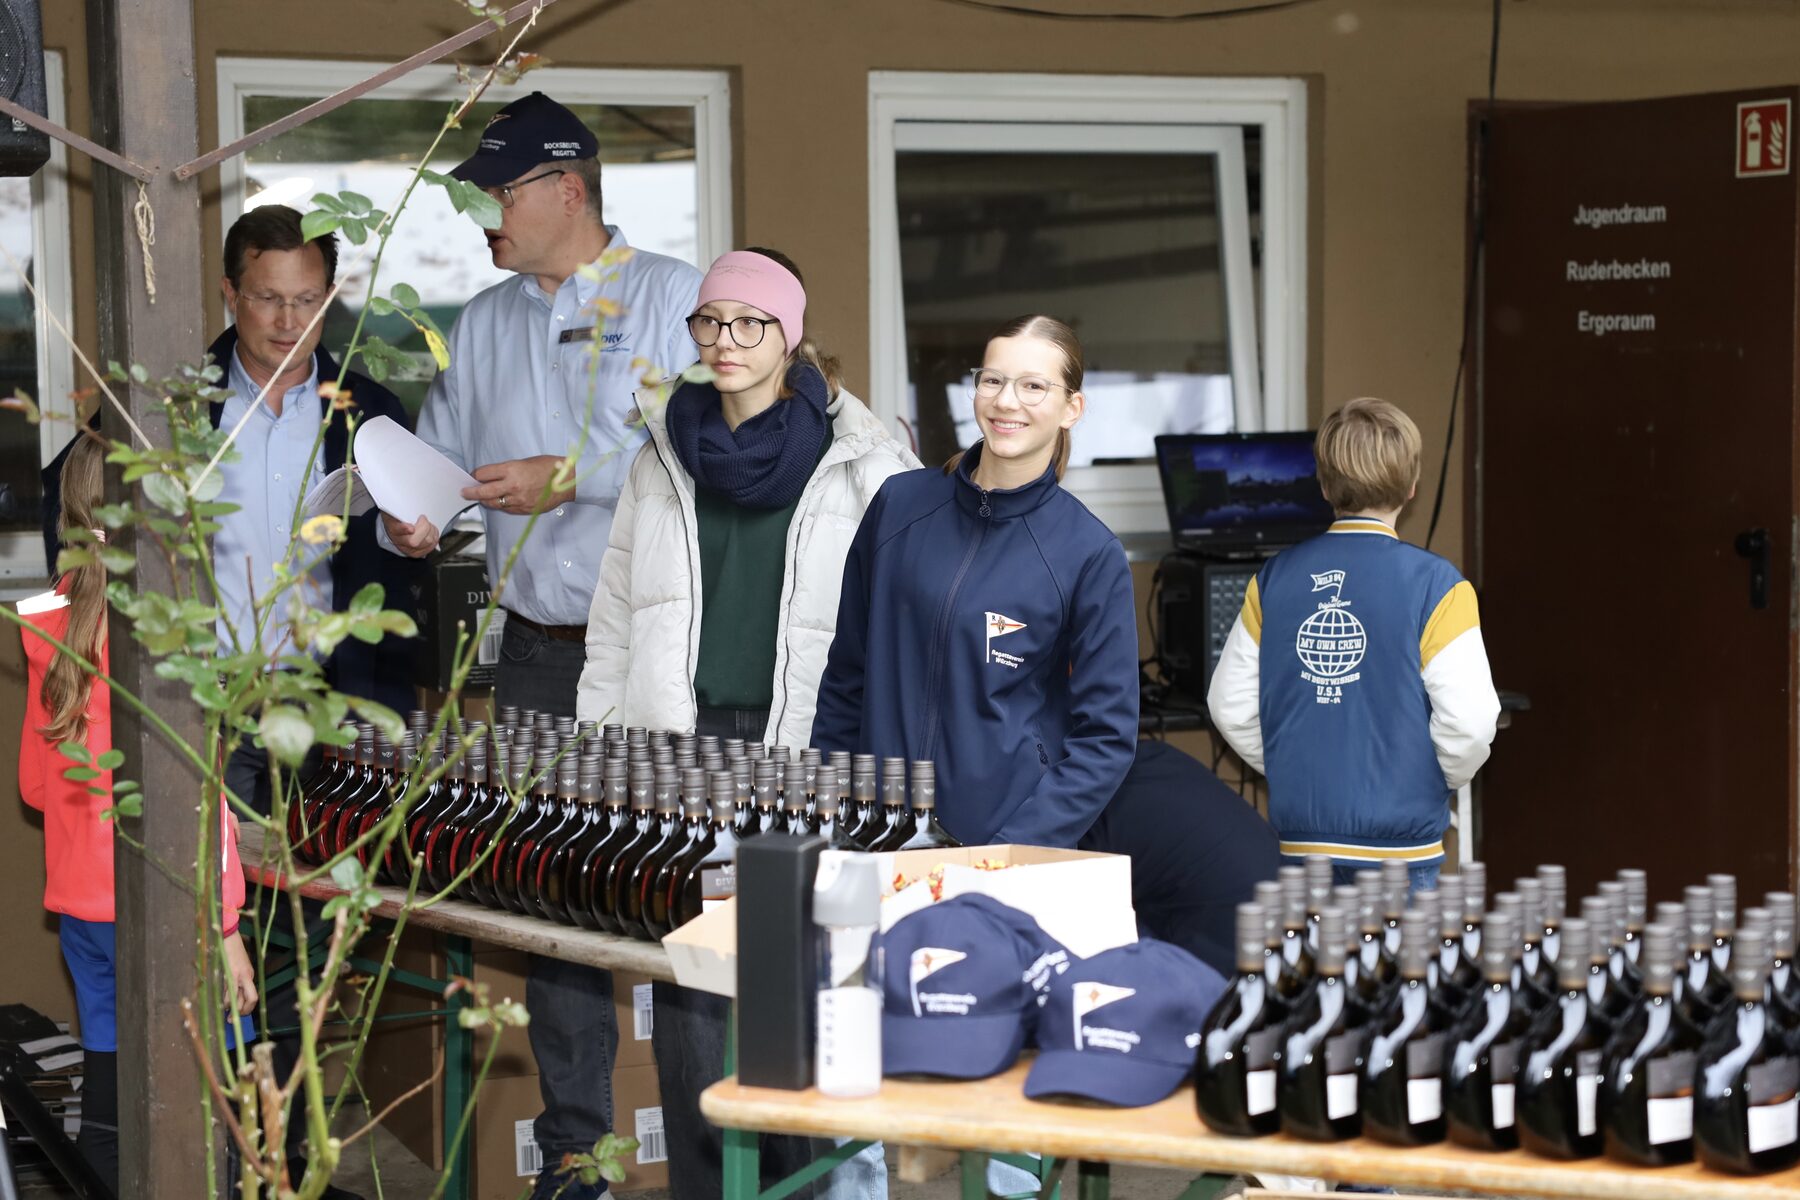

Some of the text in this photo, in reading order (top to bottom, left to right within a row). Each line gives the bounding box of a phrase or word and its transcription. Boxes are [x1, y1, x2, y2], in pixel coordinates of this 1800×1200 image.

[544, 142, 581, 150] BOCKSBEUTEL
[1573, 203, 1667, 229] Jugendraum
[1566, 258, 1671, 281] Ruderbecken
[1577, 311, 1656, 336] Ergoraum
[1300, 637, 1363, 650] MY OWN CREW
